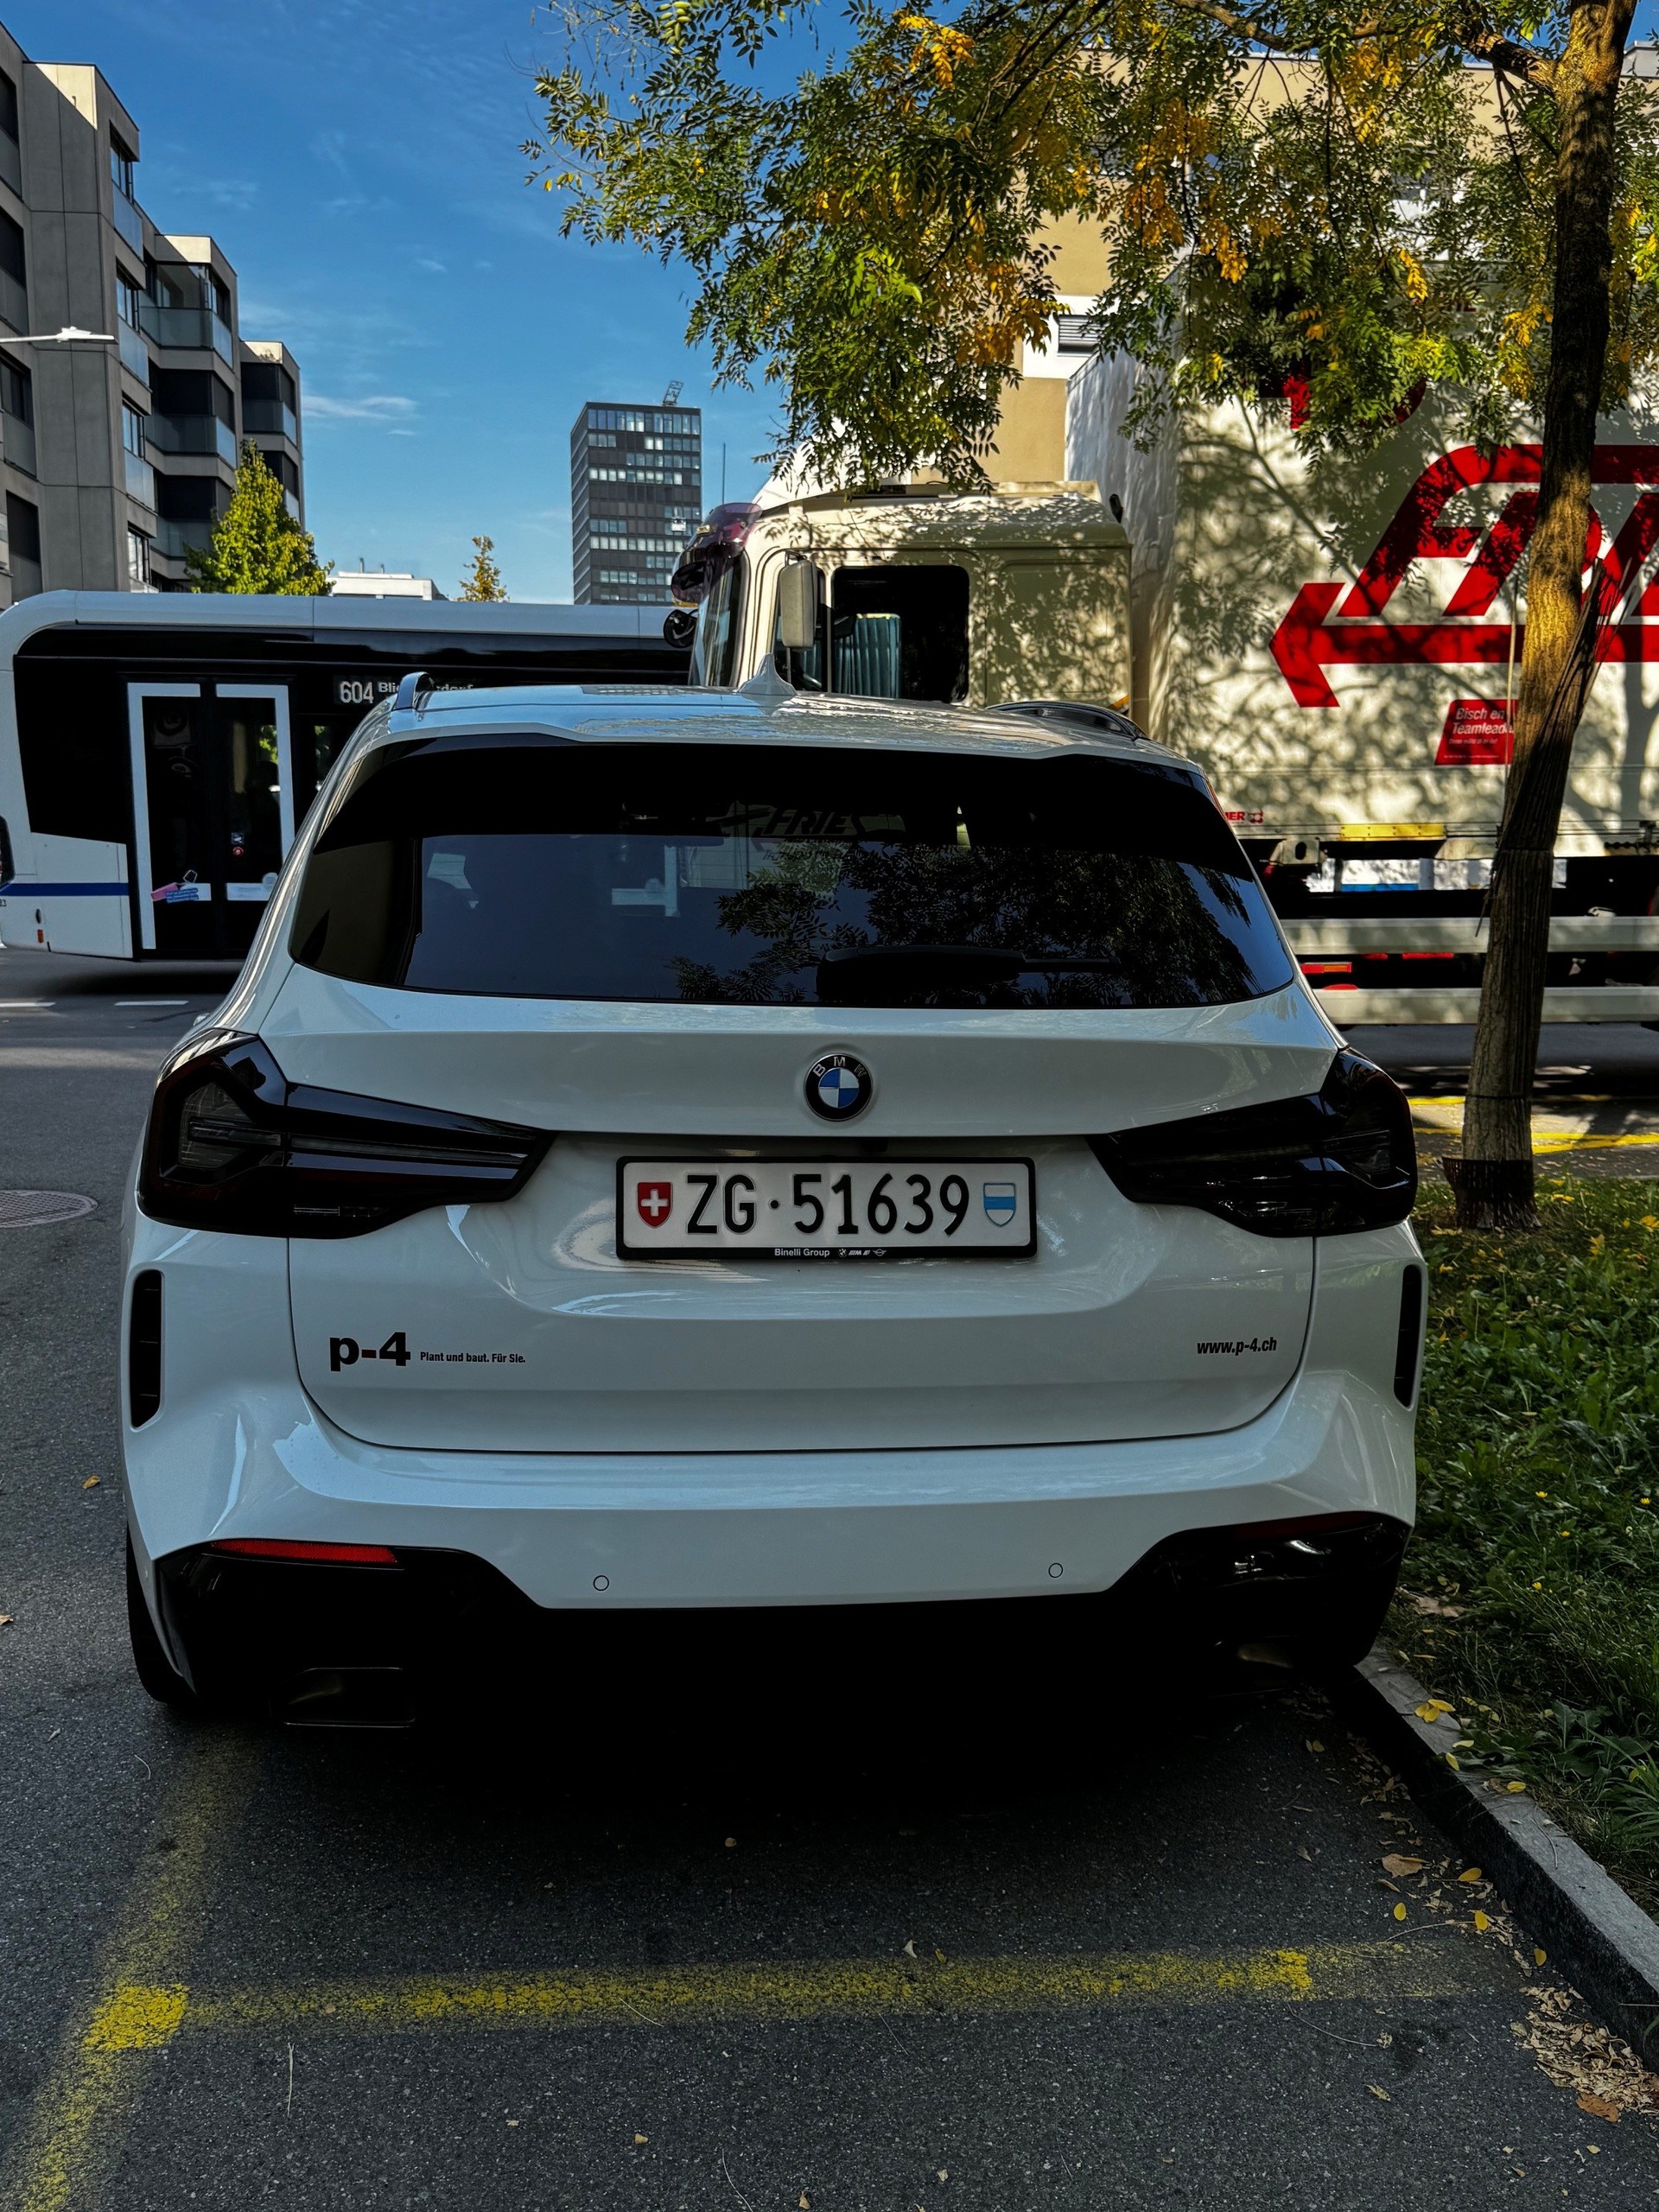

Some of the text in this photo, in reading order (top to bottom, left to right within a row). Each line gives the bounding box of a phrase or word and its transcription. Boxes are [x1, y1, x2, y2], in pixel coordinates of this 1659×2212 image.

[340, 681, 374, 703] 604
[1456, 708, 1487, 720] Bisch
[812, 1056, 867, 1077] BMW
[804, 1249, 830, 1258] Group
[329, 1332, 411, 1372] p-4
[1197, 1337, 1278, 1356] www.p-4.ch
[420, 1351, 526, 1363] Plant und baut. Für Sie.
